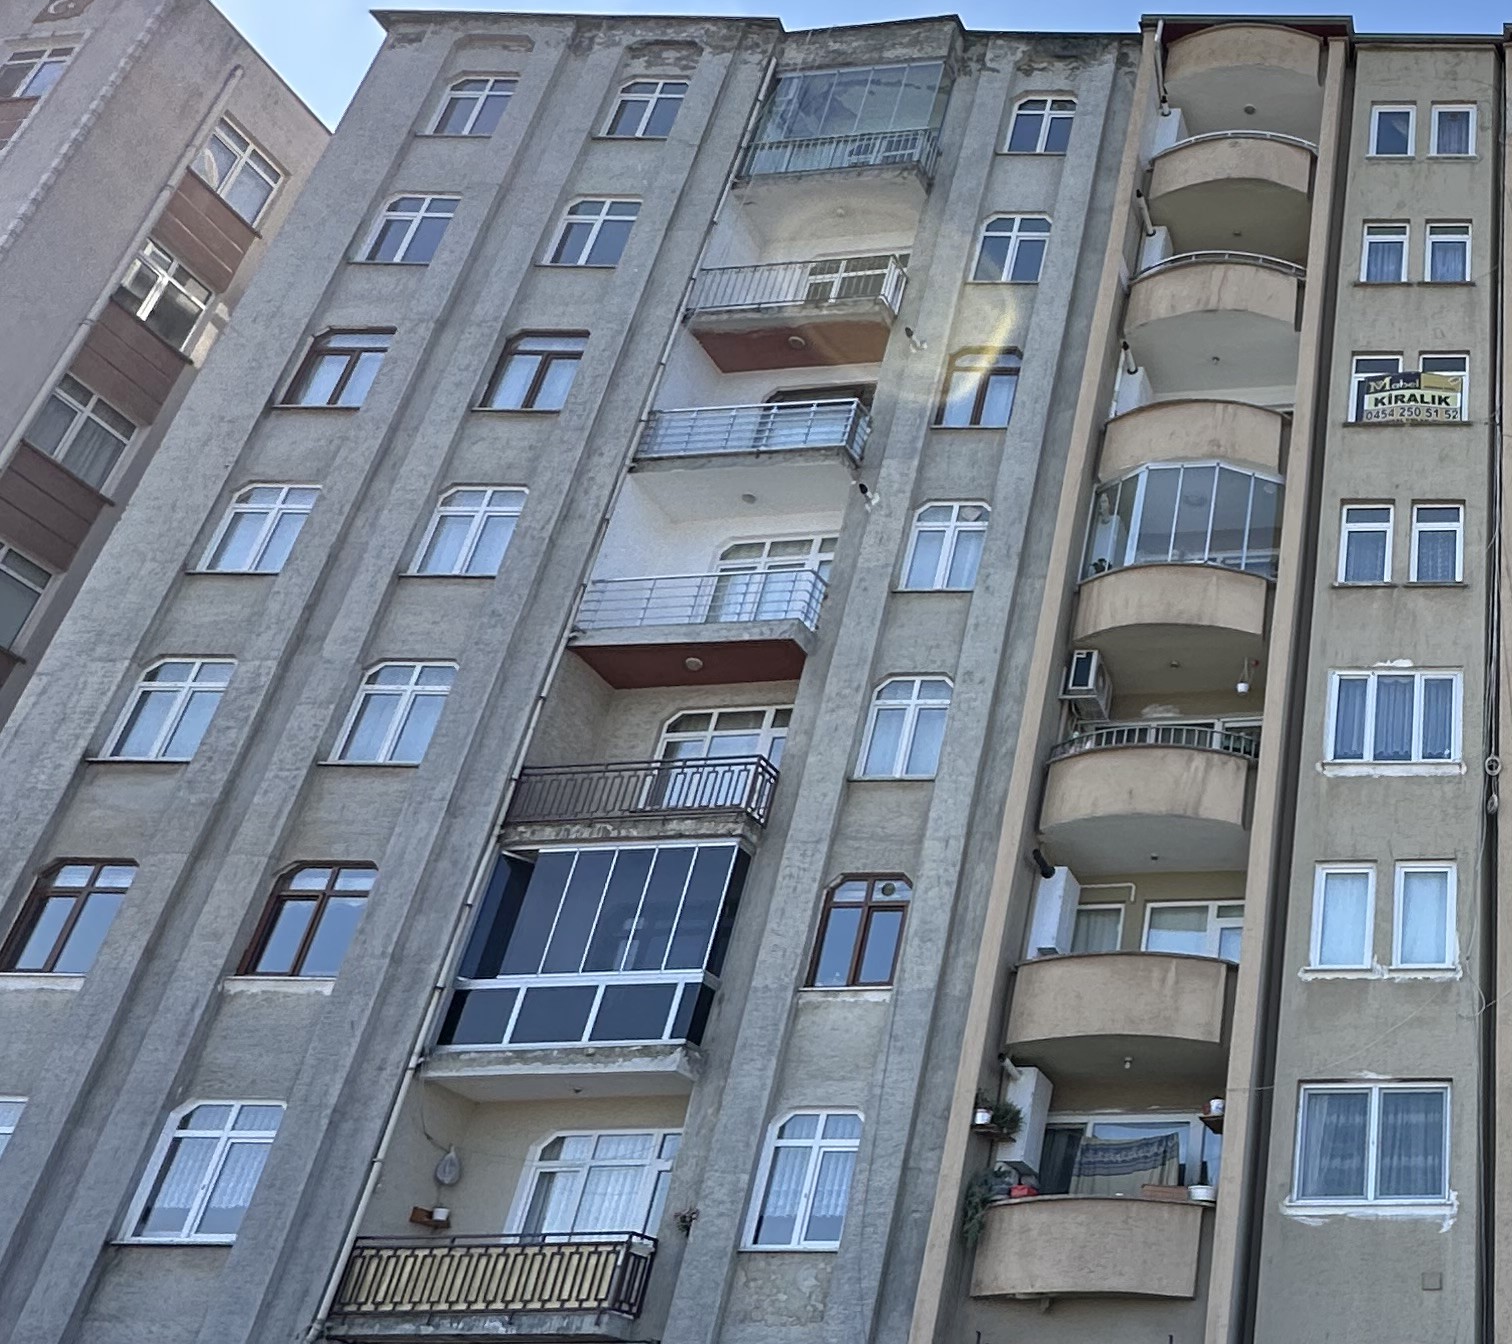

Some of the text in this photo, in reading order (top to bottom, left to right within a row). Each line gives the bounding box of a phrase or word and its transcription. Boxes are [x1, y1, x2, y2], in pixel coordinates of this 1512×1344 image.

[1374, 393, 1451, 407] KİRALIK
[1366, 409, 1394, 421] 0454
[1400, 407, 1421, 417] 250
